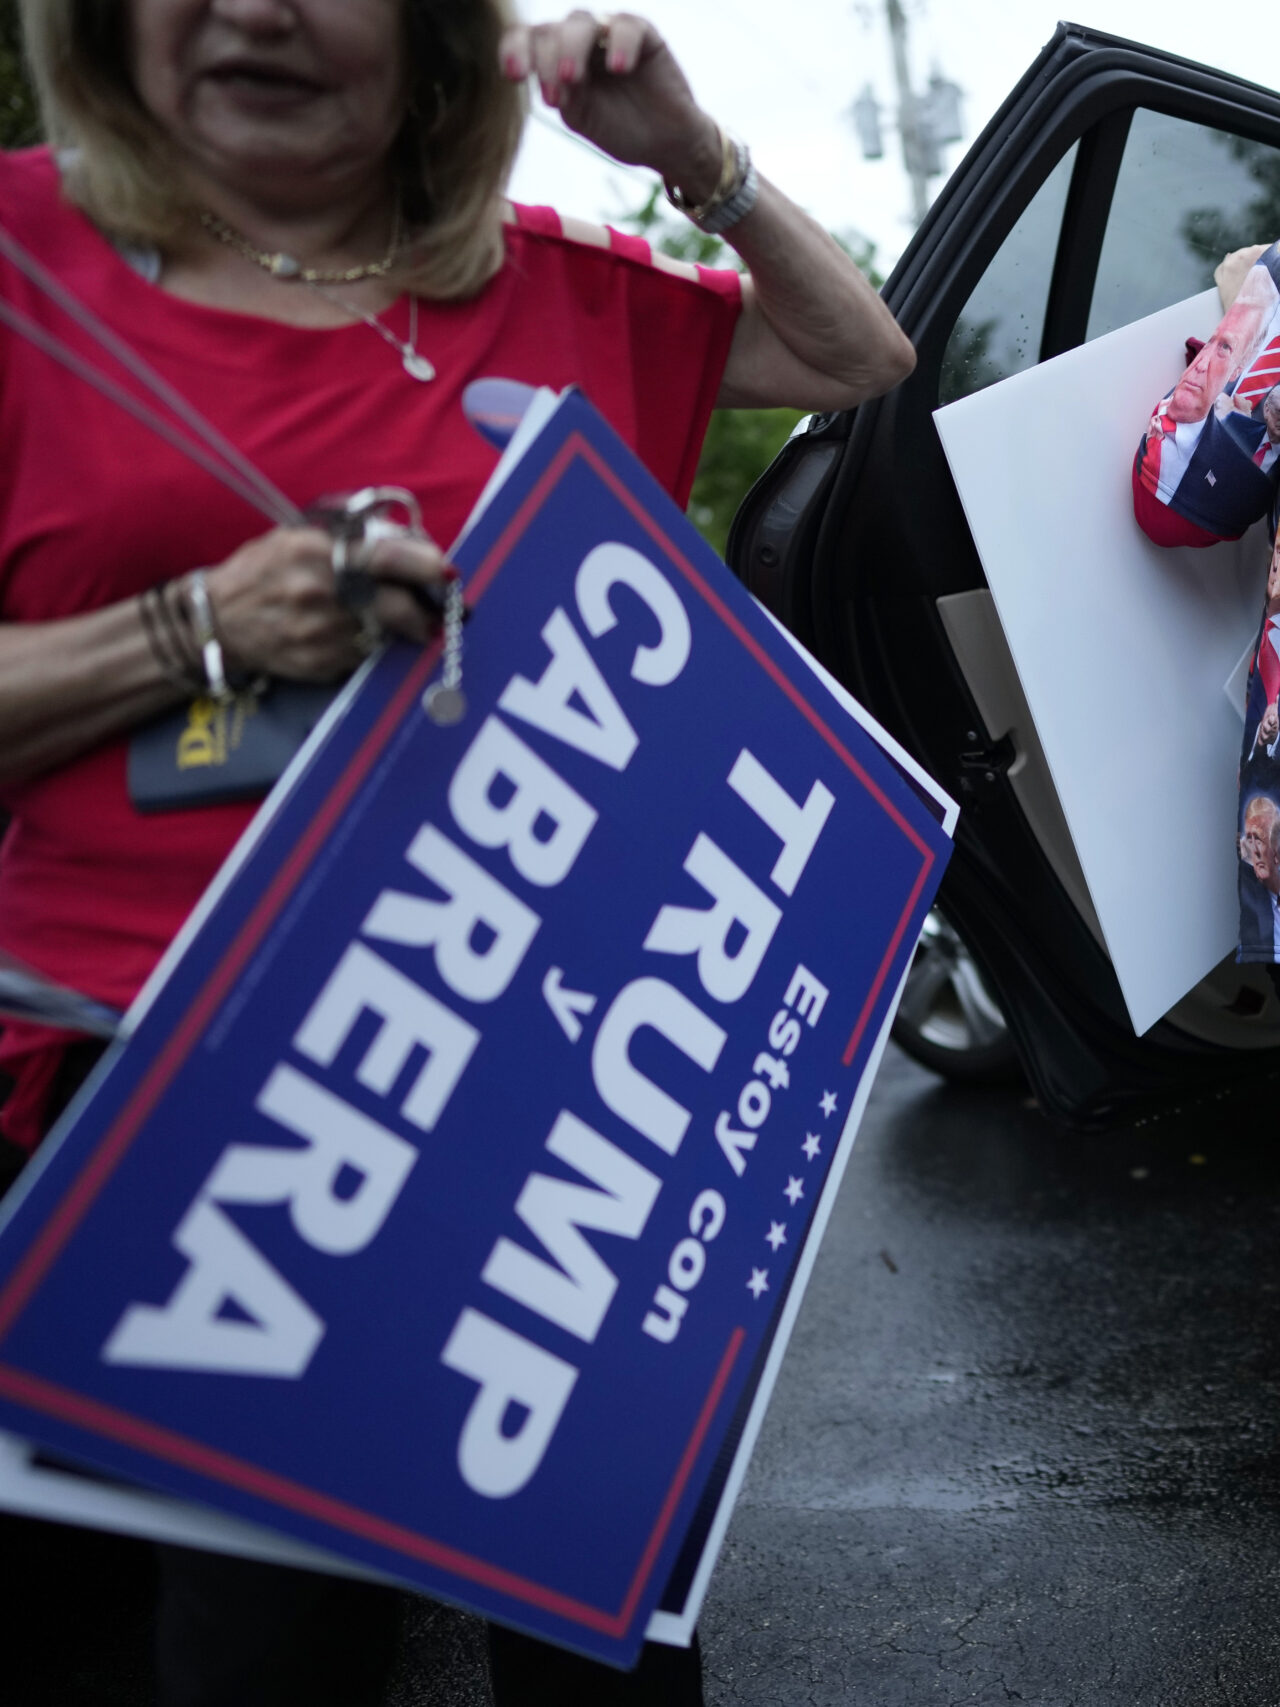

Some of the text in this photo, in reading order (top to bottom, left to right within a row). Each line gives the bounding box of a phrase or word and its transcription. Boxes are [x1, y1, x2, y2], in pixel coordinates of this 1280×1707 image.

[102, 541, 692, 1378] CABRERA
[441, 748, 836, 1499] TRUMP
[542, 967, 598, 1043] y
[641, 964, 829, 1343] Estoy con
